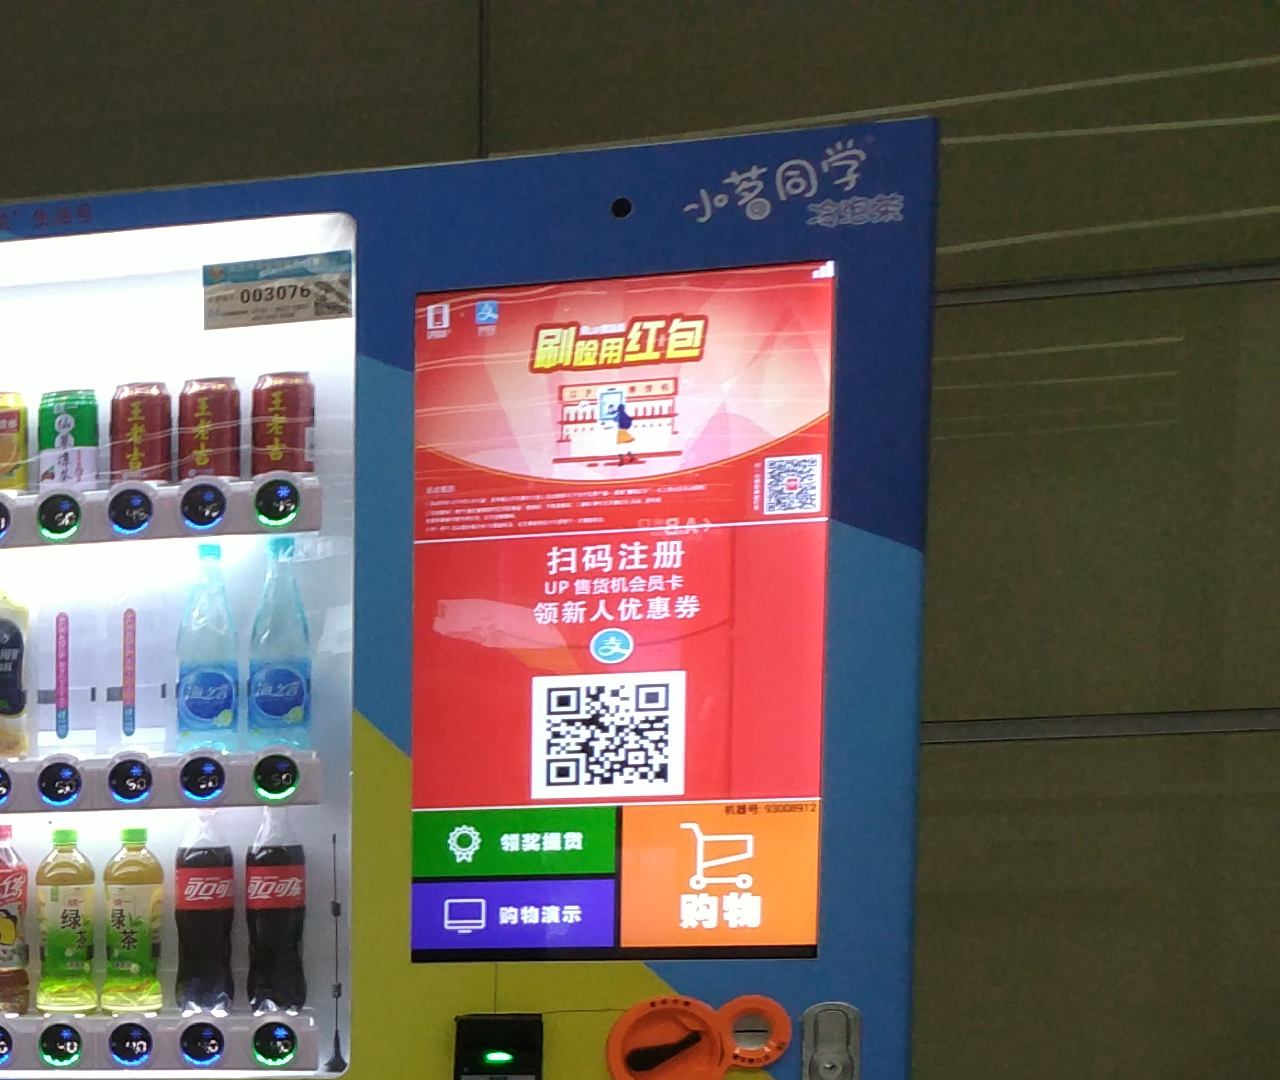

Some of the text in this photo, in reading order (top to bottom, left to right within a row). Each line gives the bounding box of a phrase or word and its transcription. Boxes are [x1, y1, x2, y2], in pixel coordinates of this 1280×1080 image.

[683, 139, 868, 224] 小茗同学
[806, 193, 904, 228] 冷泡茶
[241, 284, 311, 304] 003076
[532, 316, 706, 371] 刷脸用红包
[194, 396, 214, 467] 王老吉
[266, 391, 289, 462] 王老吉
[546, 539, 686, 576] 扫码注册
[545, 574, 684, 596] UP 售货机会员卡
[532, 594, 701, 625] 领新人优惠券
[500, 831, 584, 852] 领奖提货
[110, 907, 139, 951] 绿茶
[498, 904, 583, 926] 购物演示
[679, 892, 762, 930] 购物
